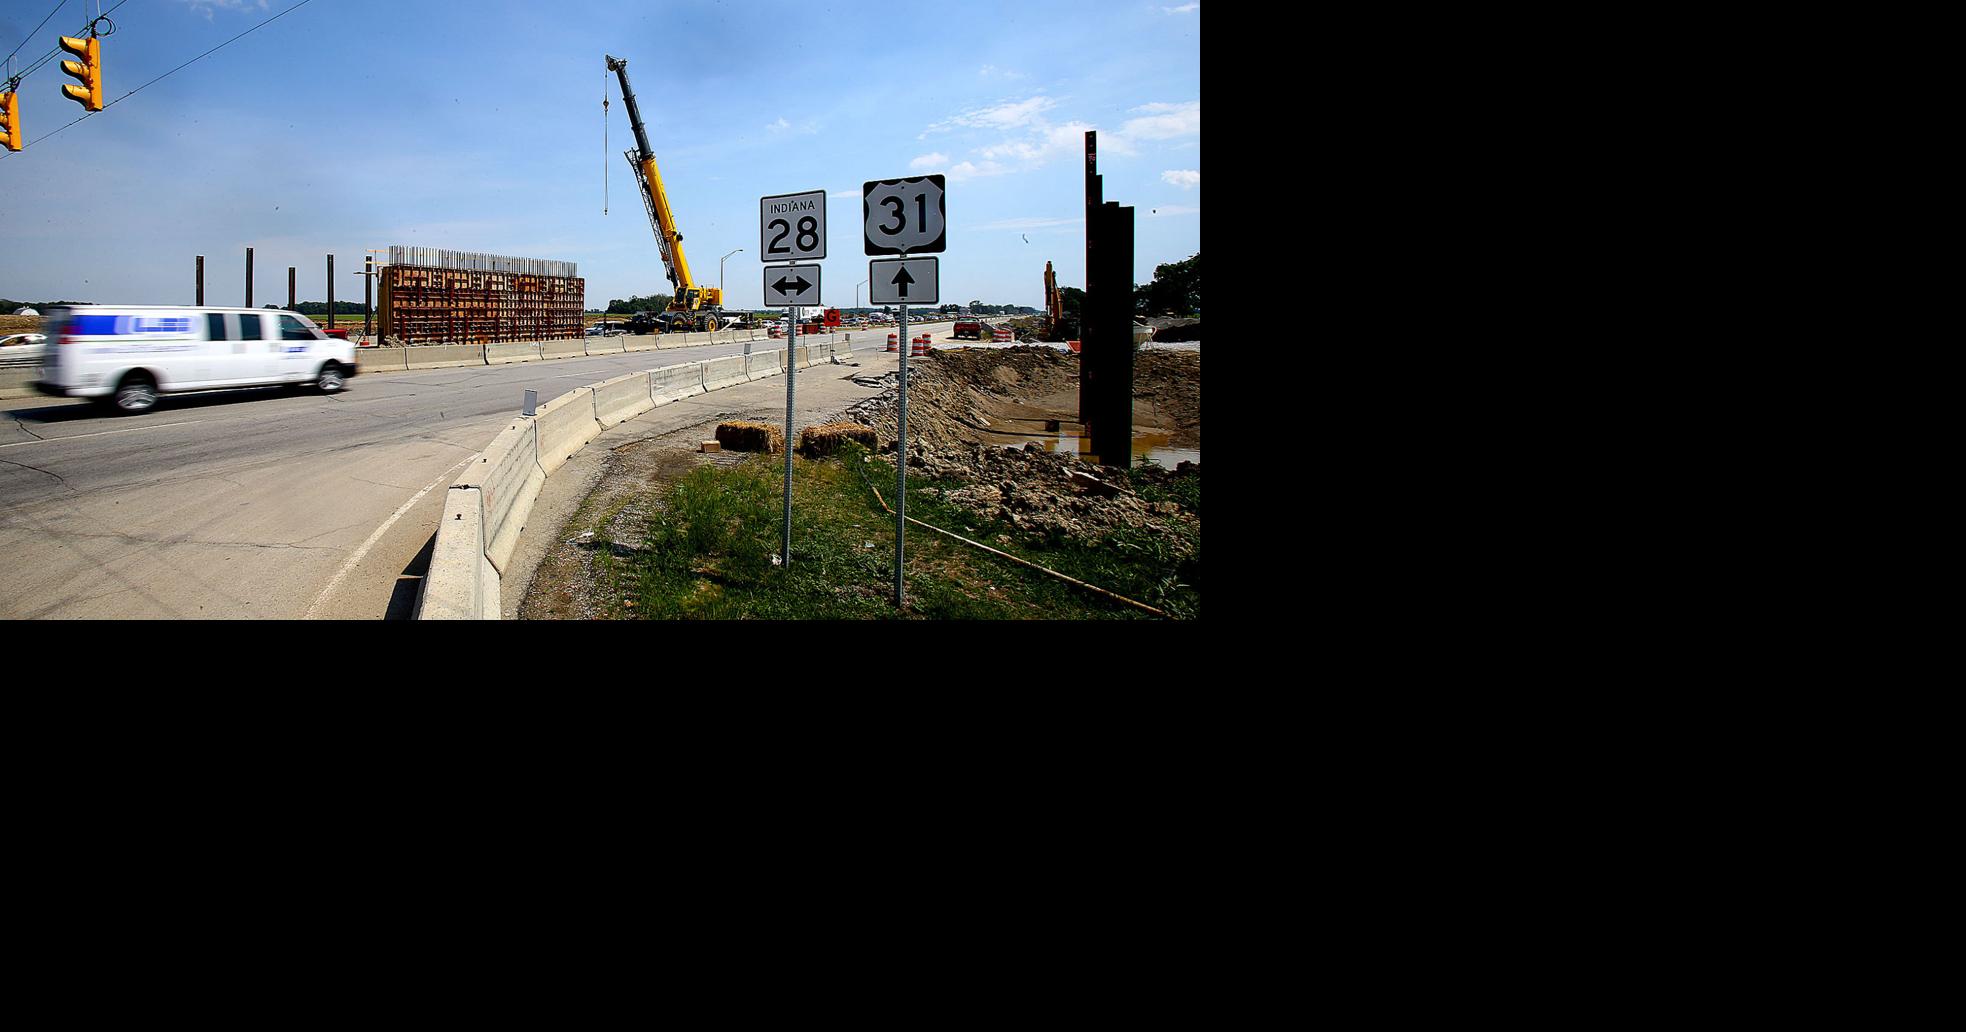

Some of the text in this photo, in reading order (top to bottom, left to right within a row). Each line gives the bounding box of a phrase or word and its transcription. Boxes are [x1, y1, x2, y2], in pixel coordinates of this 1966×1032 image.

[770, 200, 815, 213] INDIANA
[879, 193, 927, 235] 31
[767, 215, 819, 254] 28
